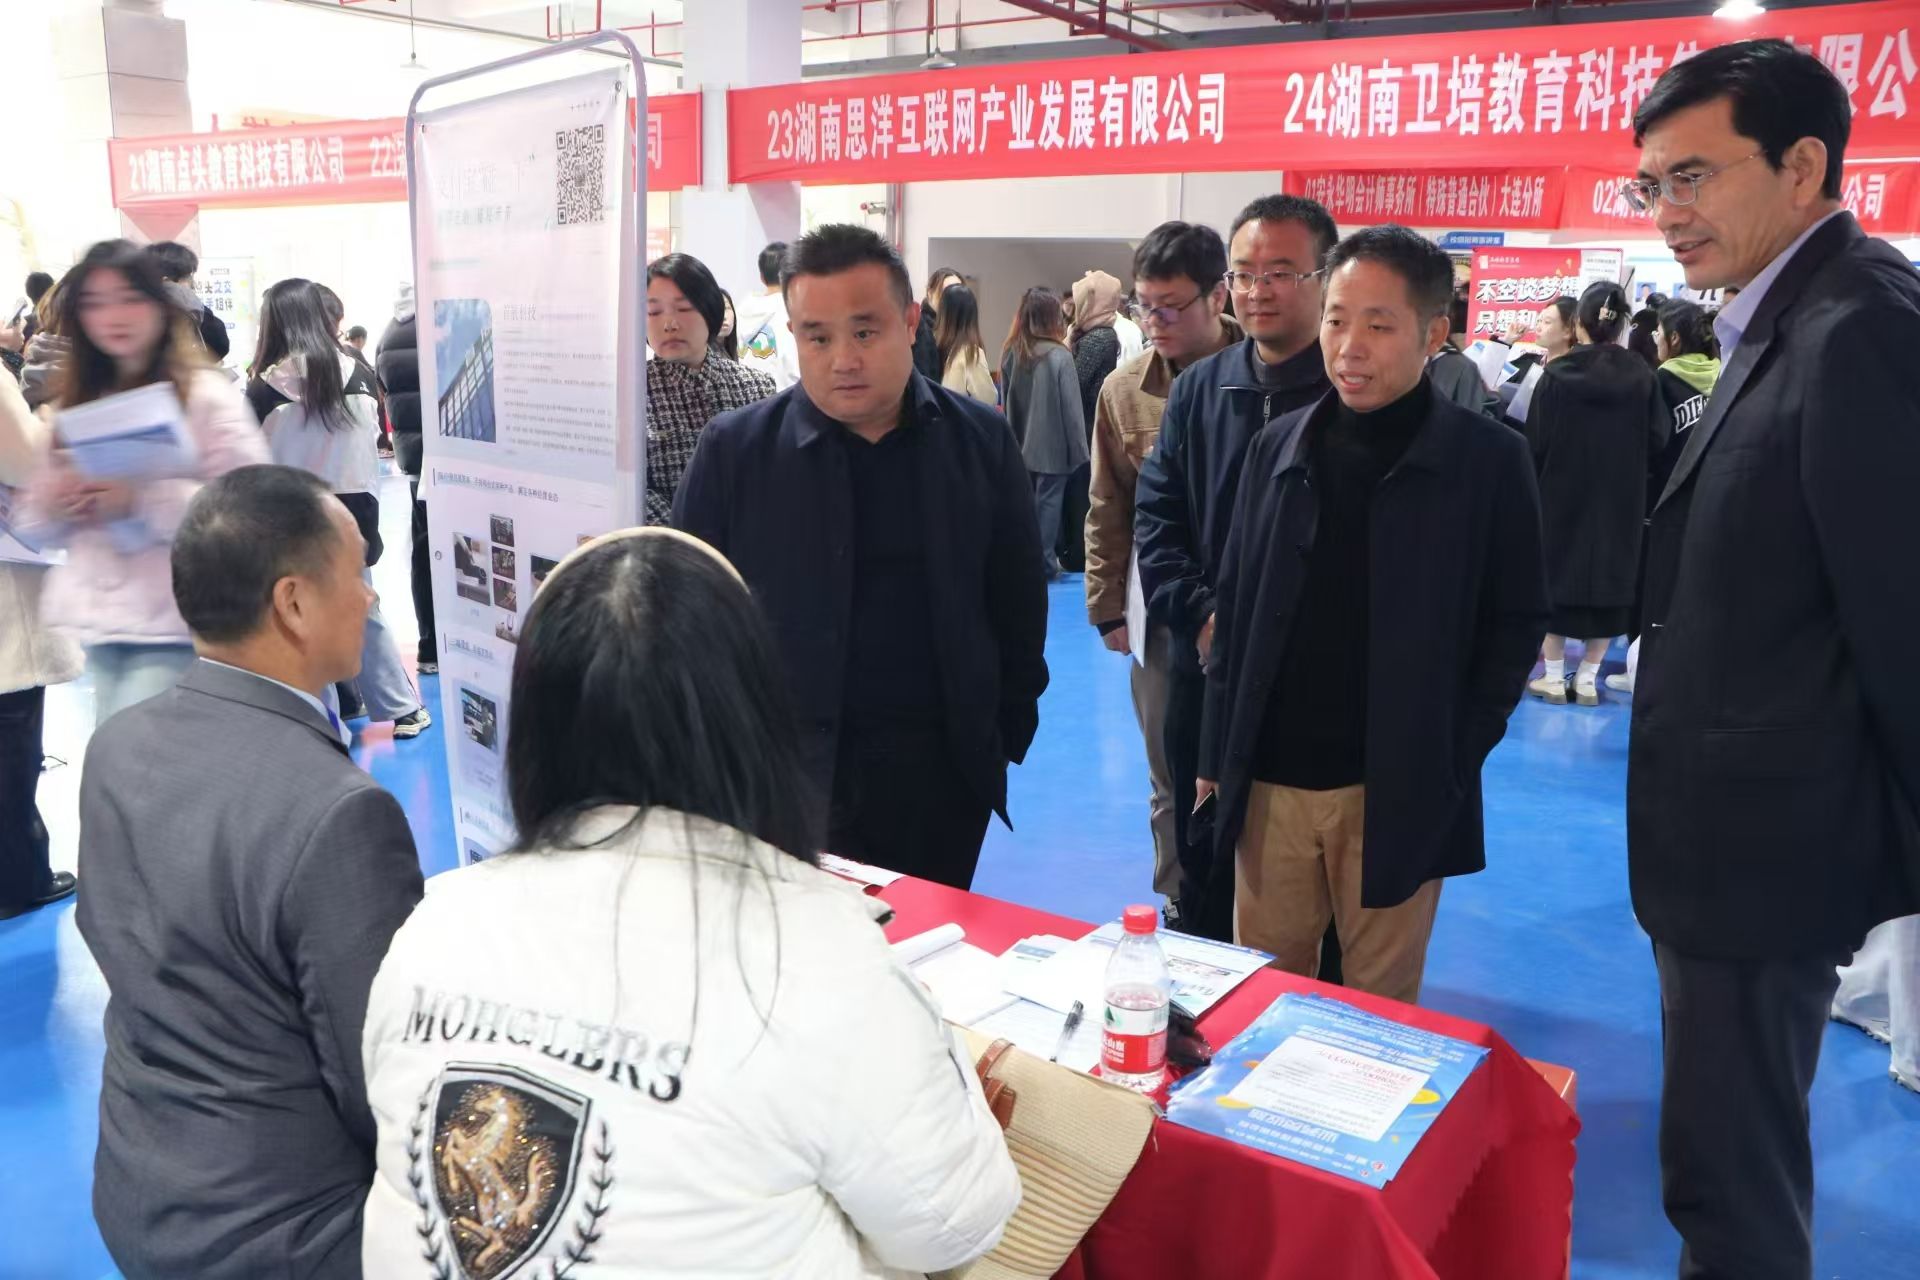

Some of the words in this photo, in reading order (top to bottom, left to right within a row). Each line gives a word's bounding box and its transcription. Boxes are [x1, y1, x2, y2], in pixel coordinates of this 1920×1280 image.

[1284, 28, 1919, 139] 24湖南卫培教育科技限公
[767, 72, 1225, 164] 23湖南思洋互联网产业发展有限公司
[129, 135, 344, 193] 21湖南点头教育科技有限公司
[1474, 309, 1542, 334] 只想和
[1673, 394, 1709, 434] DIE
